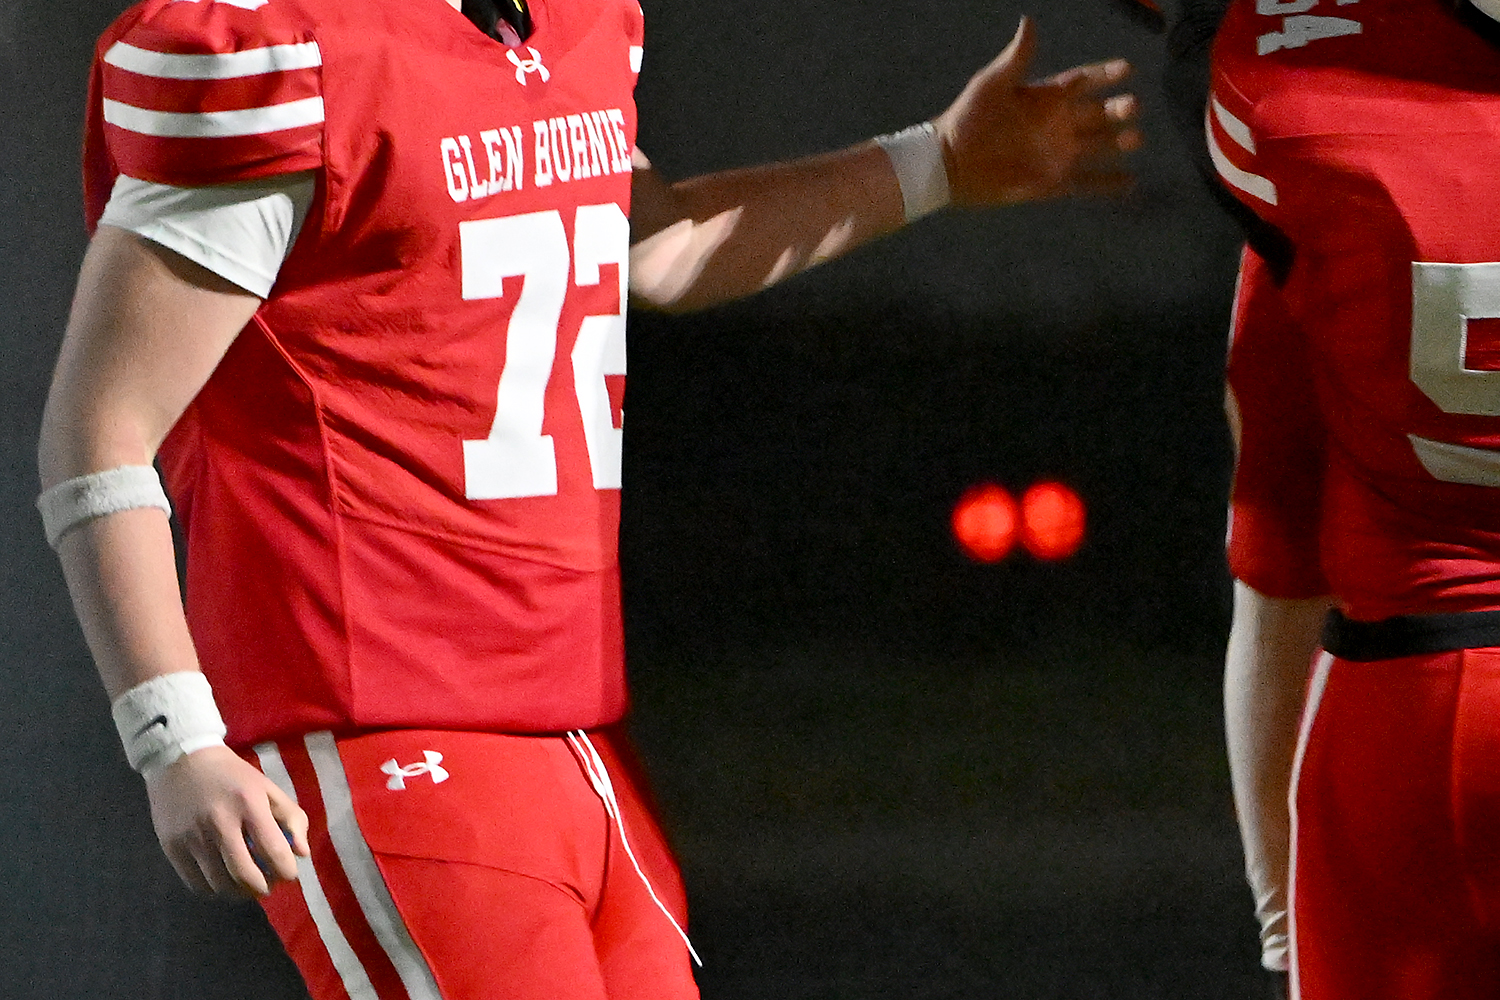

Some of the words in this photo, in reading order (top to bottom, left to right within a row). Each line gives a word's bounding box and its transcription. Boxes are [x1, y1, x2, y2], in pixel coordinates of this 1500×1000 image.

[440, 125, 523, 203] GLEN
[533, 108, 632, 187] BURNIE
[458, 202, 631, 500] 72
